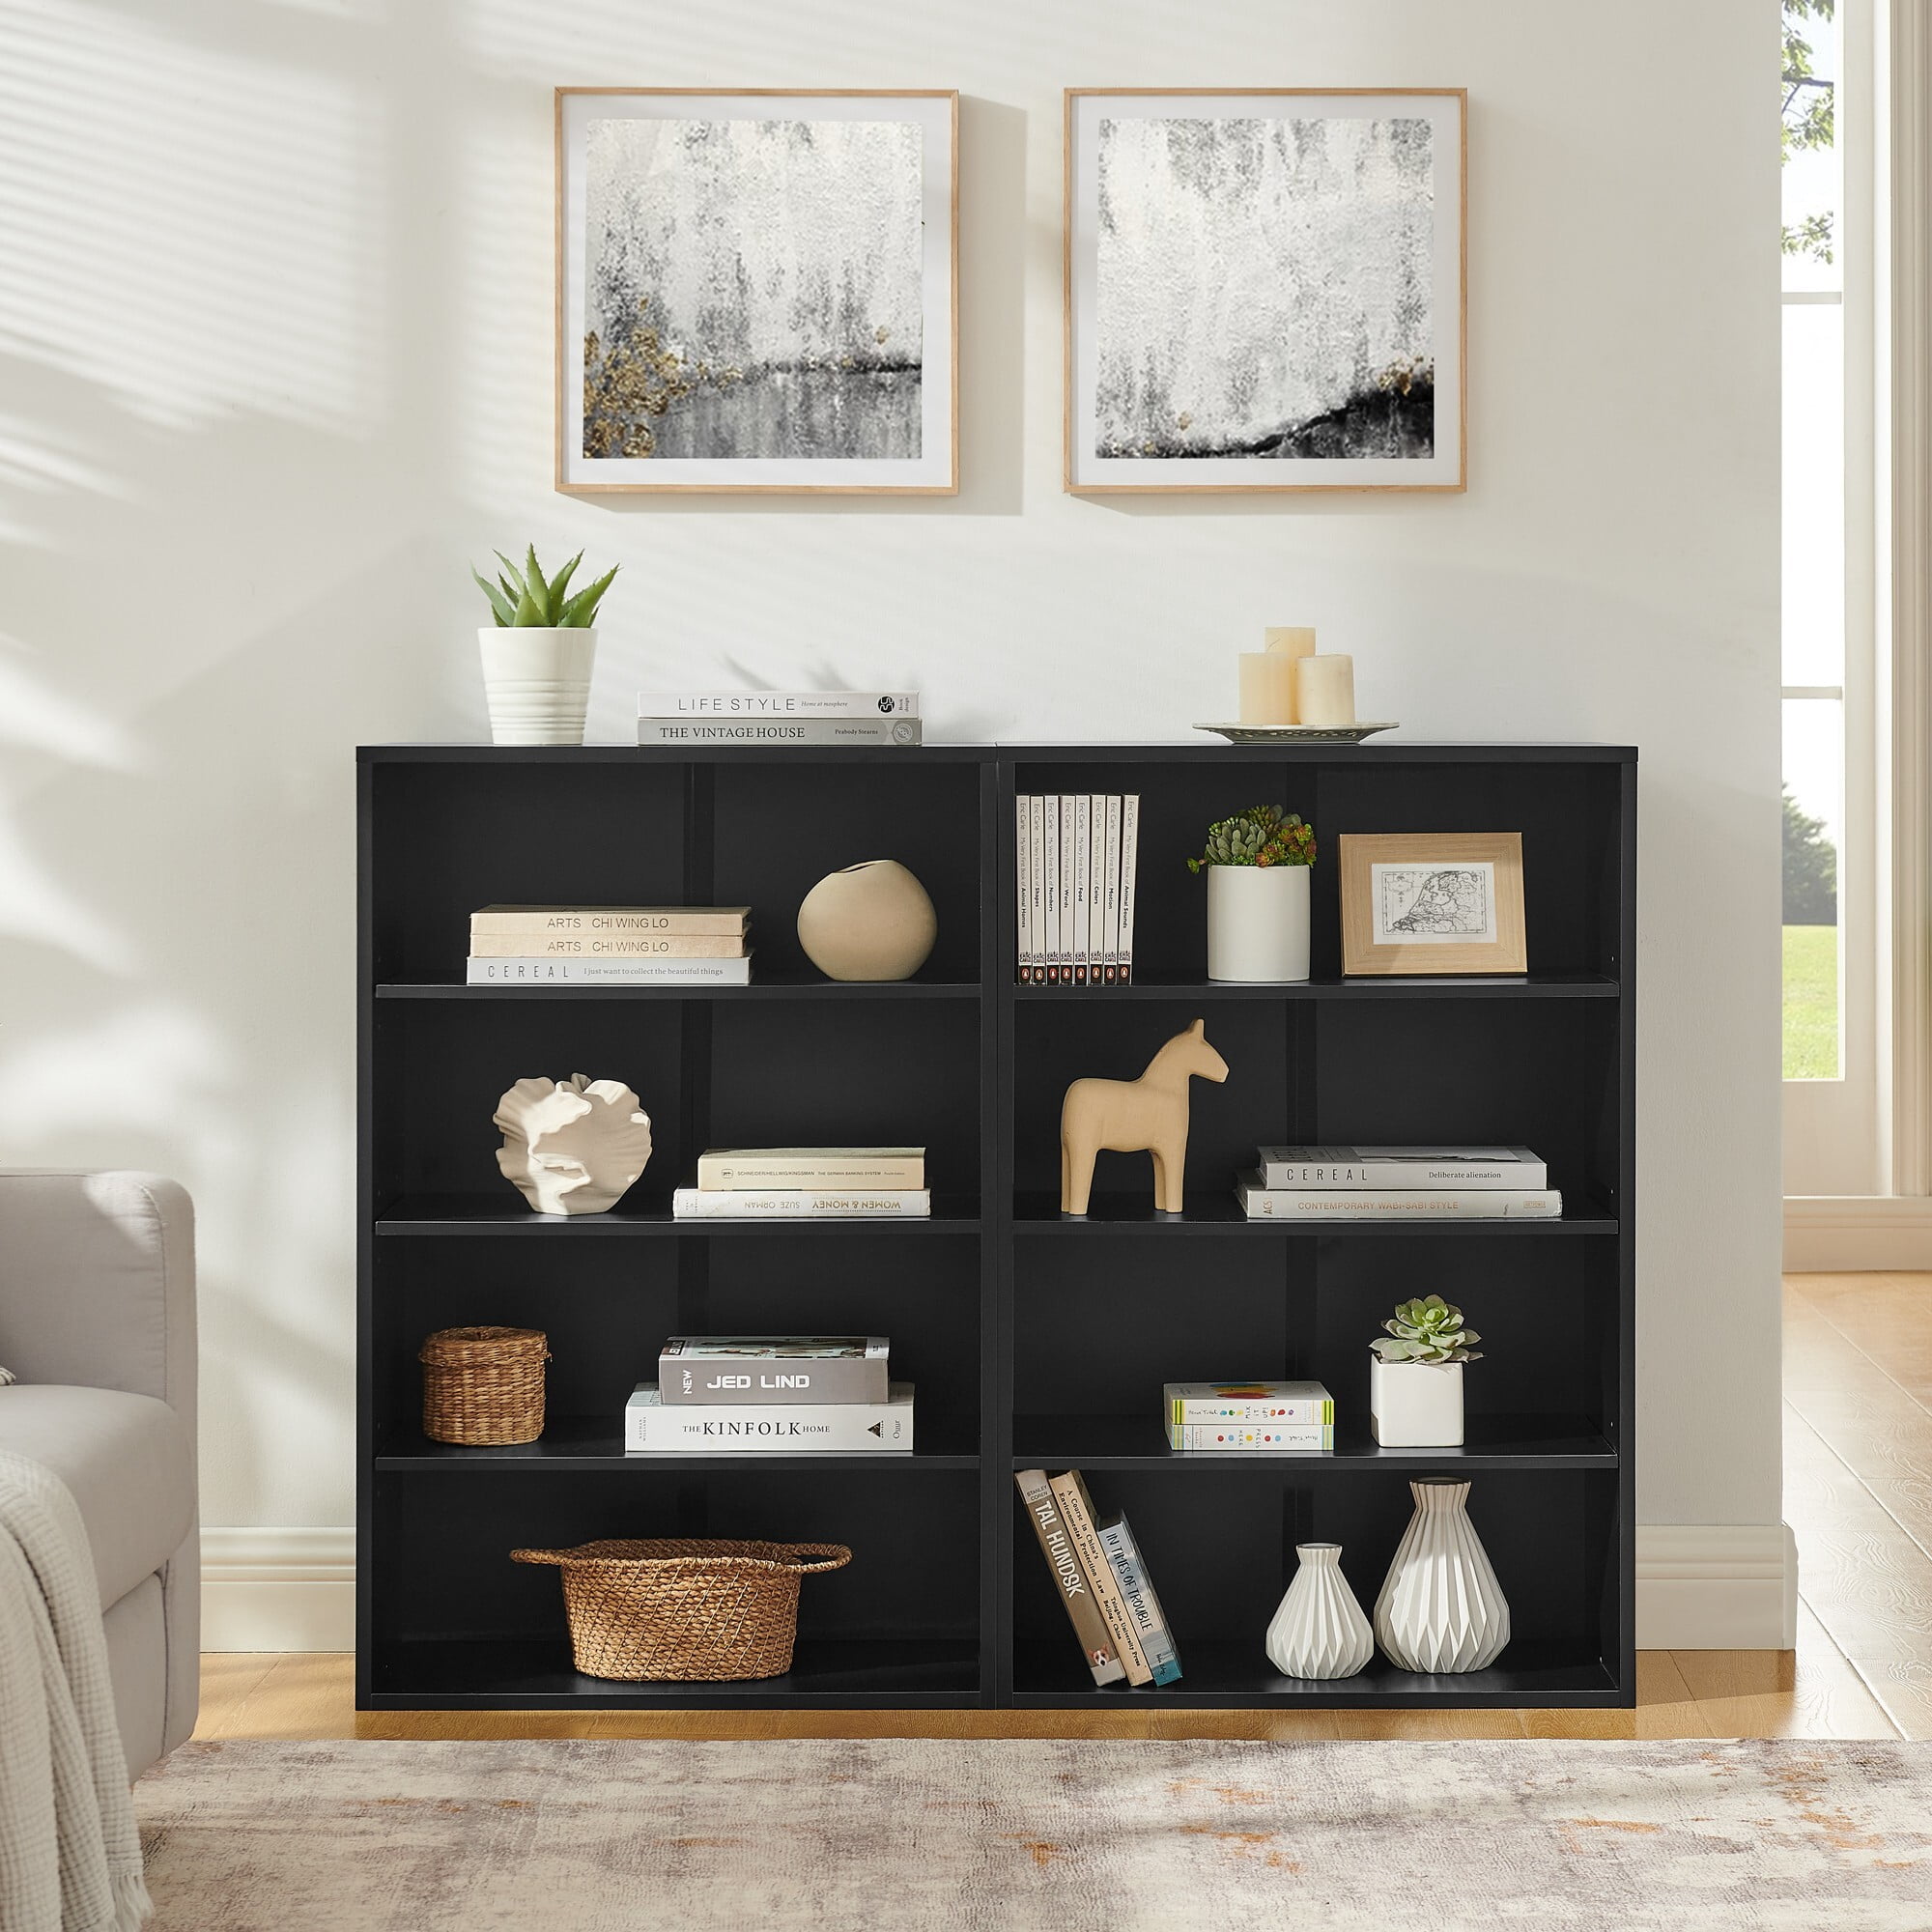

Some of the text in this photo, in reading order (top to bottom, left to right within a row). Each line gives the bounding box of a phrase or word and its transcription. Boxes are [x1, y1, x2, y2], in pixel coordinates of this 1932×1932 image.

[678, 698, 796, 711] LIFE STYLE
[660, 727, 806, 738] THE VINTAGE HOUSE
[548, 918, 669, 928] ARTS CHI WING LO
[548, 941, 669, 952] ARTS CHI WING LO
[488, 965, 570, 978] CEREAL
[587, 968, 602, 977] just
[700, 967, 724, 977] things
[1287, 1168, 1368, 1180] CEREAL
[683, 1370, 693, 1395] NEW
[706, 1375, 810, 1389] JED LIND
[702, 1421, 802, 1435] KINFOLK
[1026, 1485, 1047, 1497] STANLEY
[1030, 1491, 1048, 1502] COREN
[1070, 1497, 1084, 1521] Course
[1085, 1533, 1098, 1560] China's
[1035, 1500, 1085, 1599] TAL HUNDSK
[1059, 1492, 1105, 1594] Environmental Protection Law
[1106, 1533, 1153, 1632] IN TIMES OF TROUBLE
[1111, 1596, 1141, 1666] Tsinghua University Press
[1112, 1622, 1122, 1640] China
